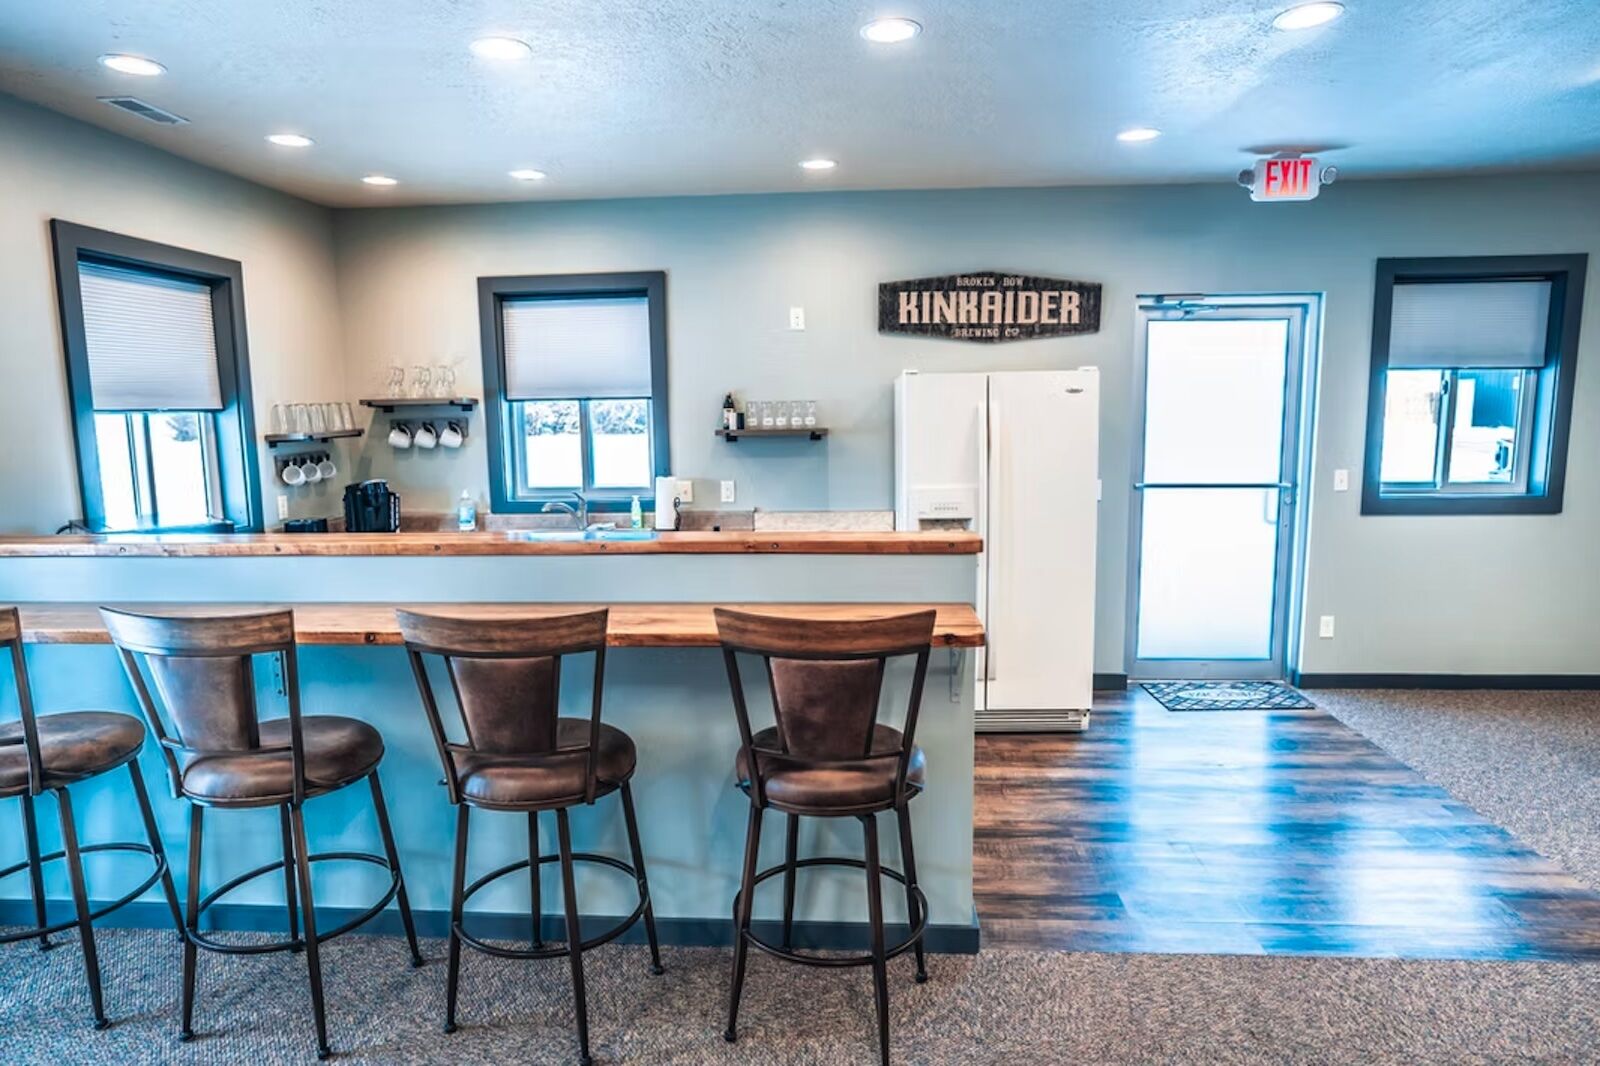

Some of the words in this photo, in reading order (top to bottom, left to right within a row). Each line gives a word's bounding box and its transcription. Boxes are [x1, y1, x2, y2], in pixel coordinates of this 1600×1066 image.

[1265, 160, 1312, 195] EXIT
[956, 277, 995, 287] BROKEN
[1003, 277, 1024, 287] BOW
[899, 290, 1080, 324] KINKAIDER
[954, 327, 1000, 338] BREWING
